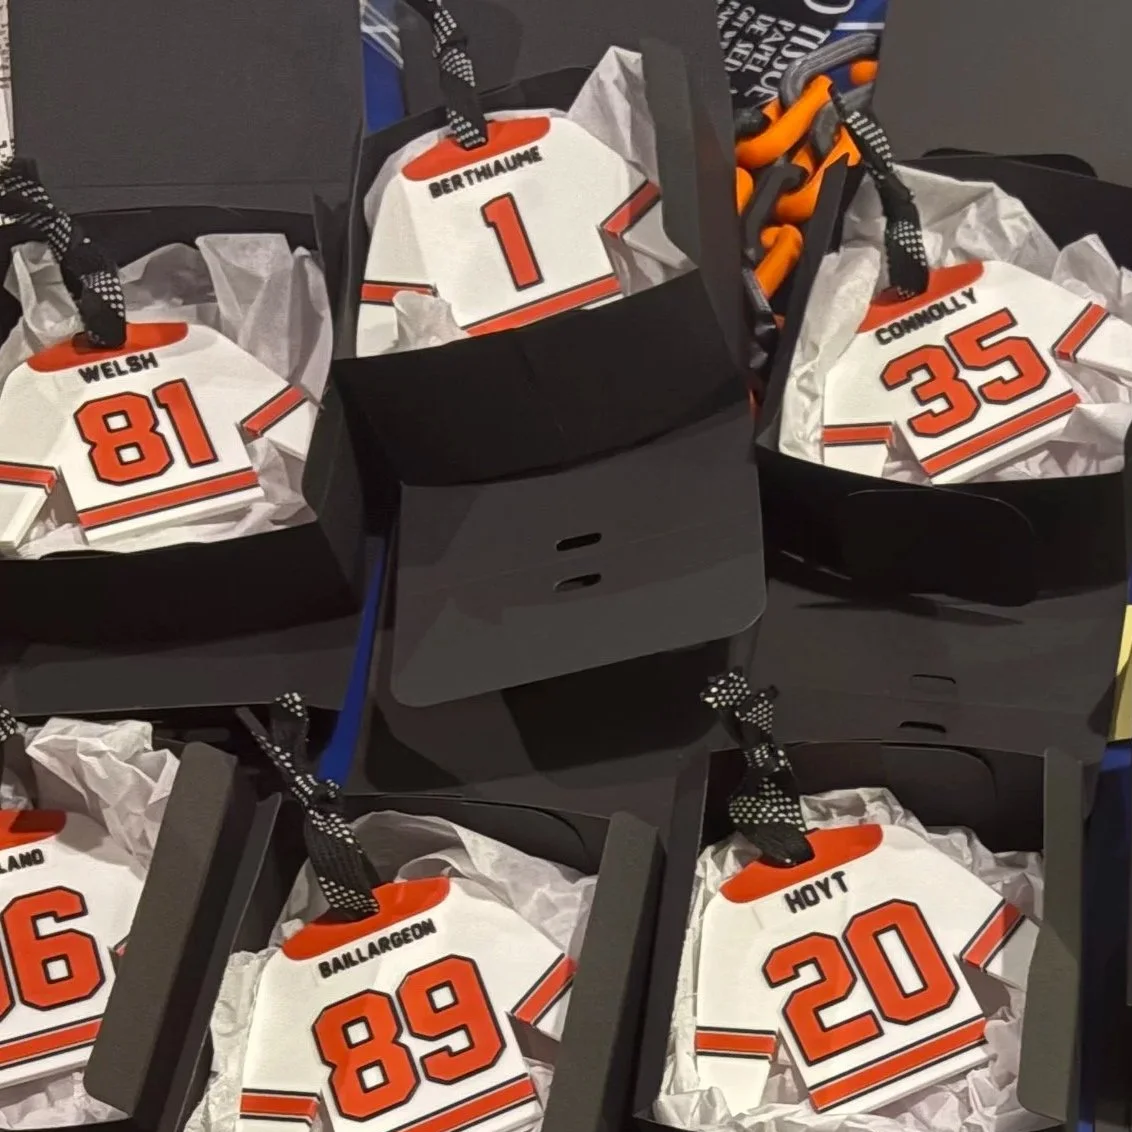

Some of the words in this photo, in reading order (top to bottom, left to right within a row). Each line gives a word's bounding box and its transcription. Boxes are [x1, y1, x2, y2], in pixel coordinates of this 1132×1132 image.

[743, 19, 796, 72] PAPEL
[746, 14, 776, 35] DE
[429, 147, 543, 199] BERTHIAUME
[481, 193, 543, 290] 1
[874, 288, 979, 345] CONNOLLY
[78, 353, 159, 384] WELSH
[881, 307, 1050, 437] 35
[73, 379, 219, 486] 81
[0, 849, 45, 873] AND
[783, 871, 852, 914] HOYT
[0, 886, 105, 1022] 6
[318, 919, 437, 979] BAILLARGEON
[762, 898, 960, 1066] 20
[312, 954, 507, 1122] 89
